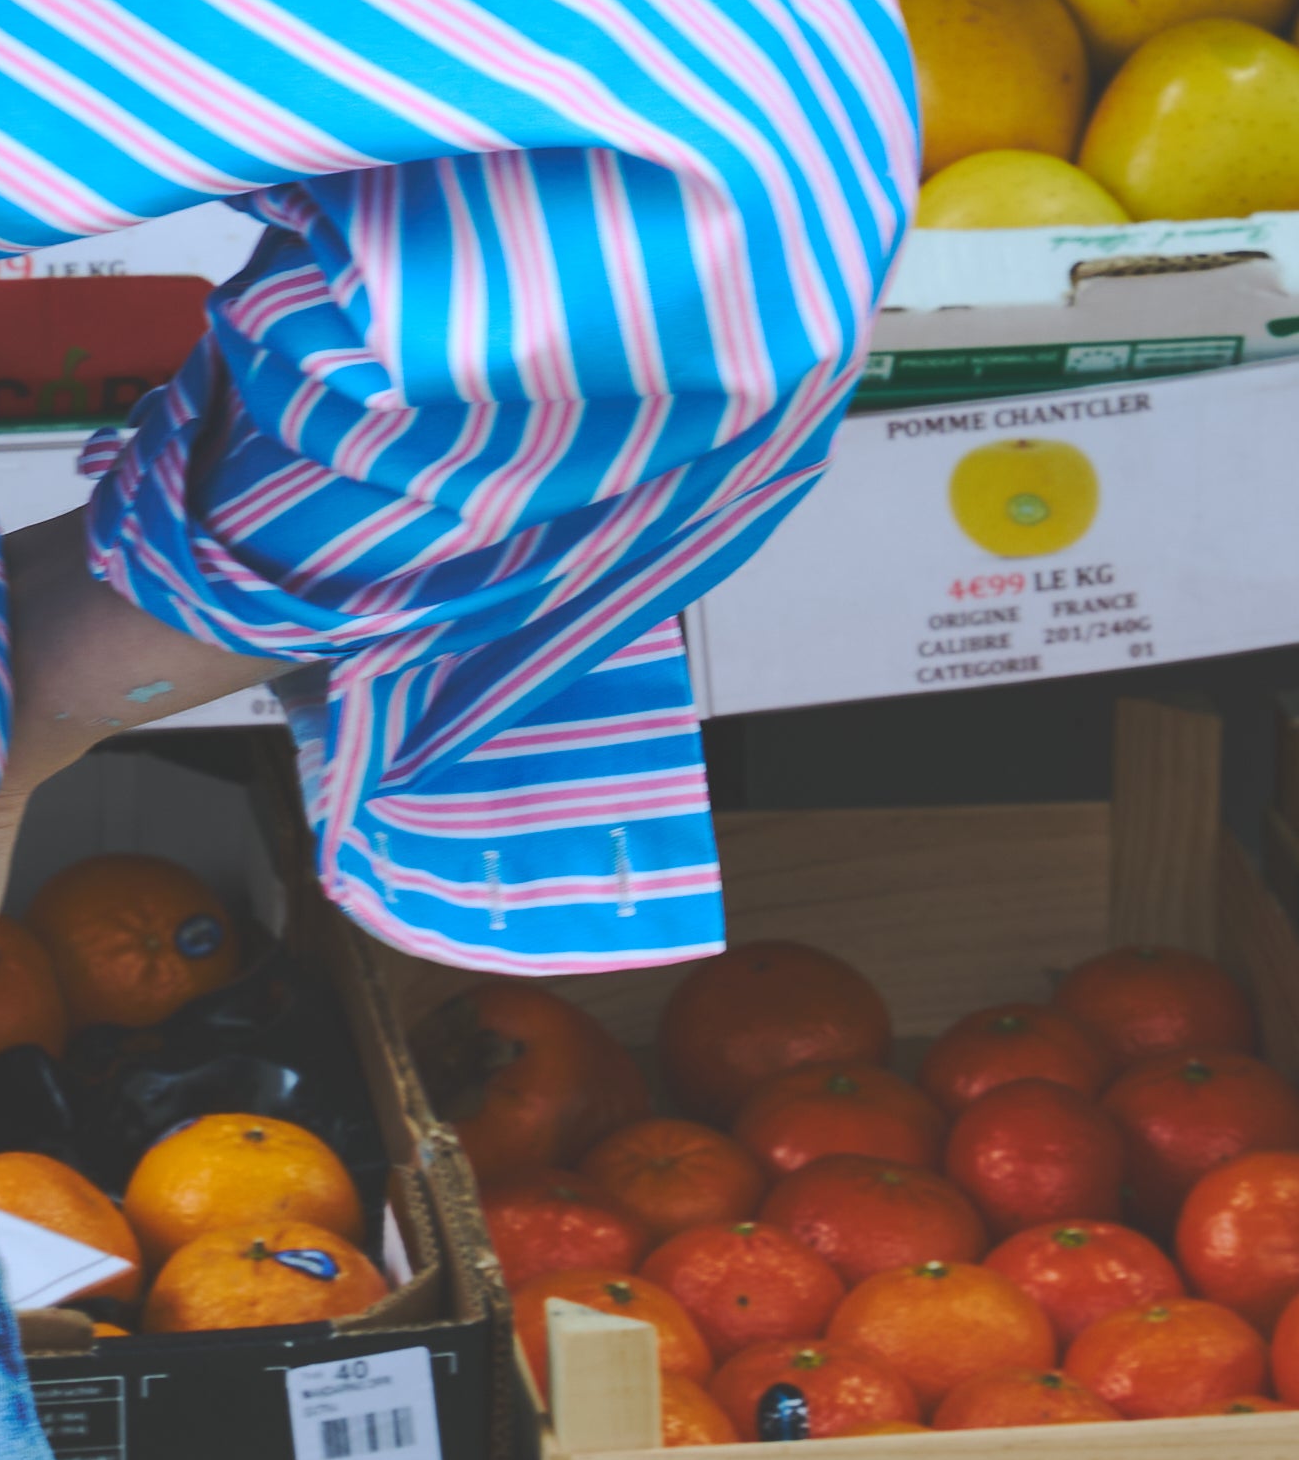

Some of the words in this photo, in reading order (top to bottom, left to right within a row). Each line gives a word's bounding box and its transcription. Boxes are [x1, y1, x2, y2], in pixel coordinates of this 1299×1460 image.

[886, 411, 987, 441] POMME
[993, 391, 1154, 429] CHANTCLER
[946, 572, 1026, 600] 4€99
[1033, 568, 1069, 593] LE
[1074, 564, 1115, 589] KG
[927, 605, 1021, 630] ORIGINE
[1051, 592, 1138, 618] FRANCE
[917, 631, 1012, 659] CALIBRE
[915, 655, 1042, 685] CATEGORIE
